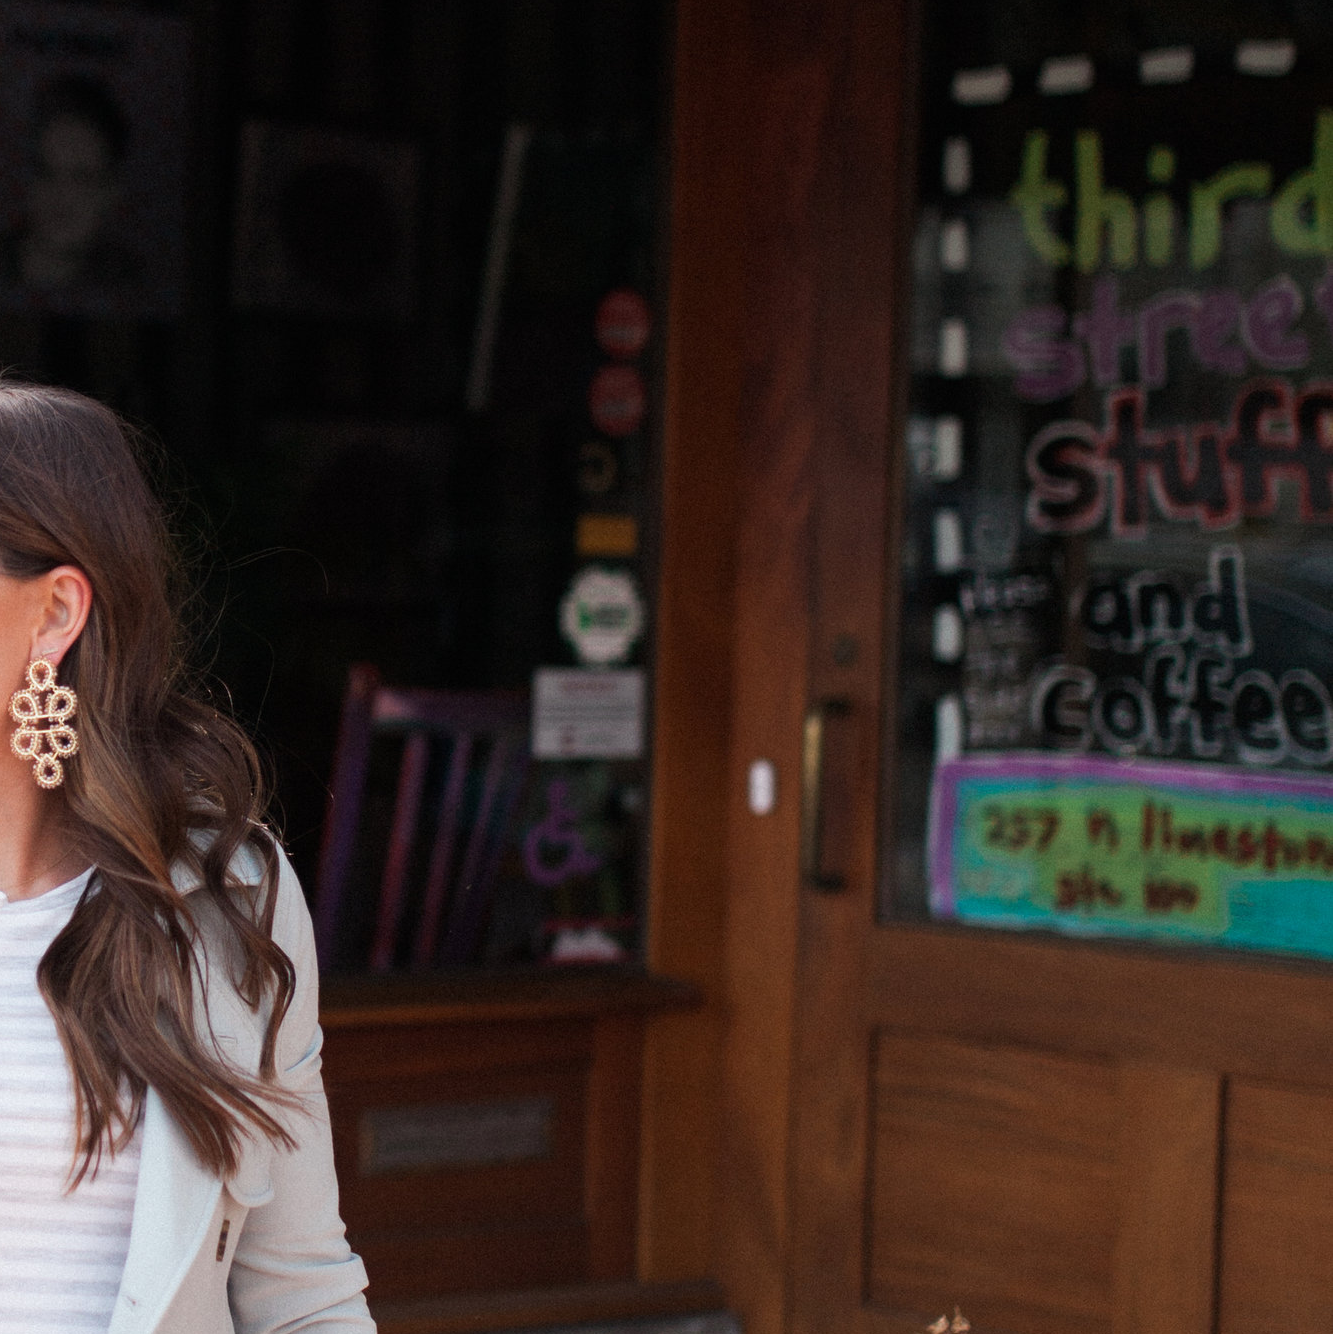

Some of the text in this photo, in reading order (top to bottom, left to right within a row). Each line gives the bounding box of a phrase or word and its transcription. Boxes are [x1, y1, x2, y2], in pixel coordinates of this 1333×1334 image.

[1009, 107, 1333, 274] third
[1001, 264, 1333, 403] stree
[1071, 543, 1253, 658] and
